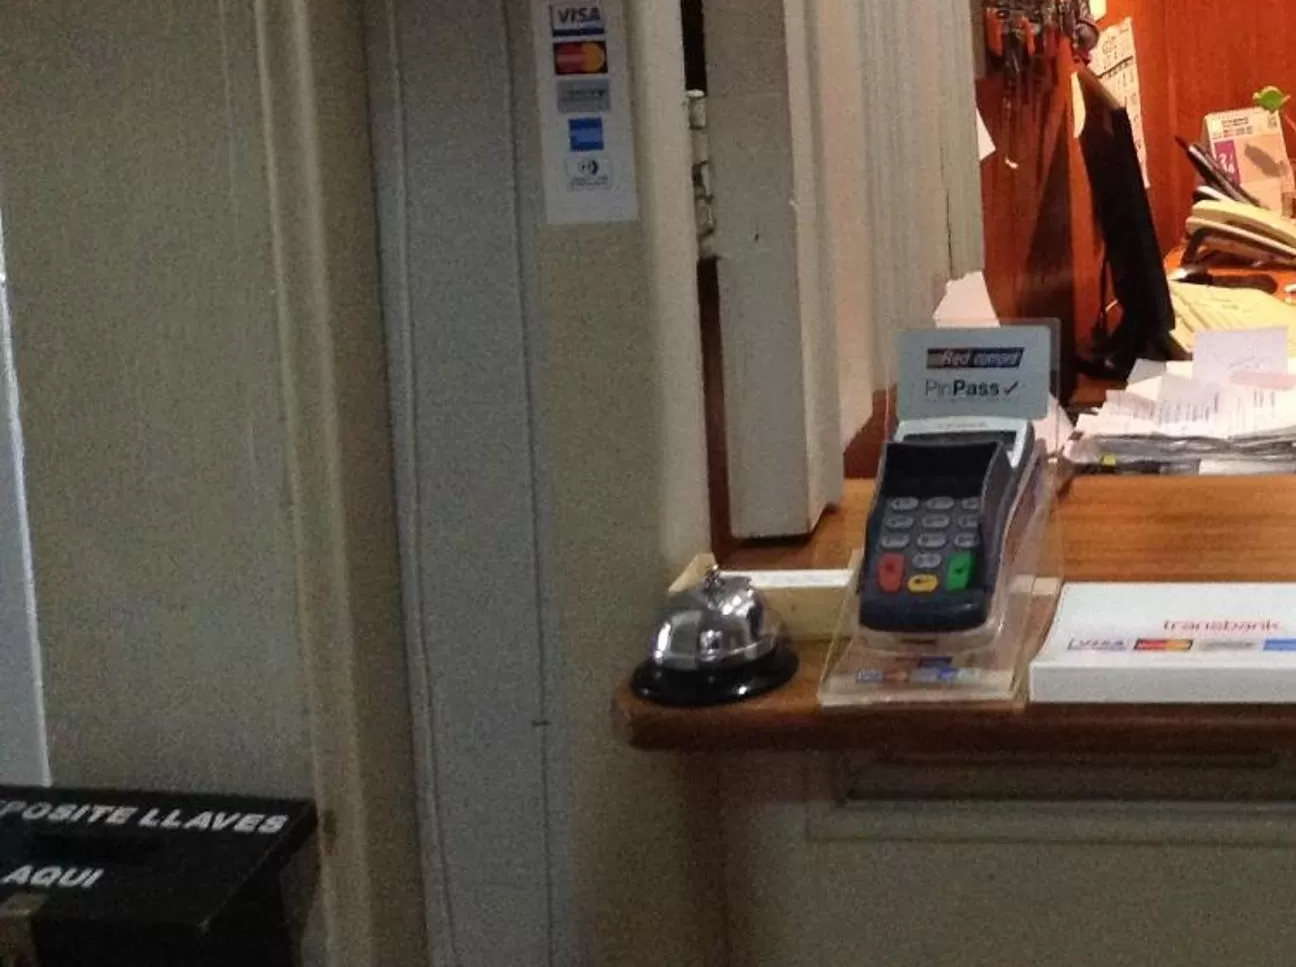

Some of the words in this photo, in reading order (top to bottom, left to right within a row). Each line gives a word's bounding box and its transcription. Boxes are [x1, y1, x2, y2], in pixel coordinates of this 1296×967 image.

[557, 7, 601, 24] VISA
[924, 379, 1000, 397] PinPass
[0, 799, 139, 826] POSITE
[138, 808, 289, 834] LLAVES
[0, 864, 104, 889] AQUI
